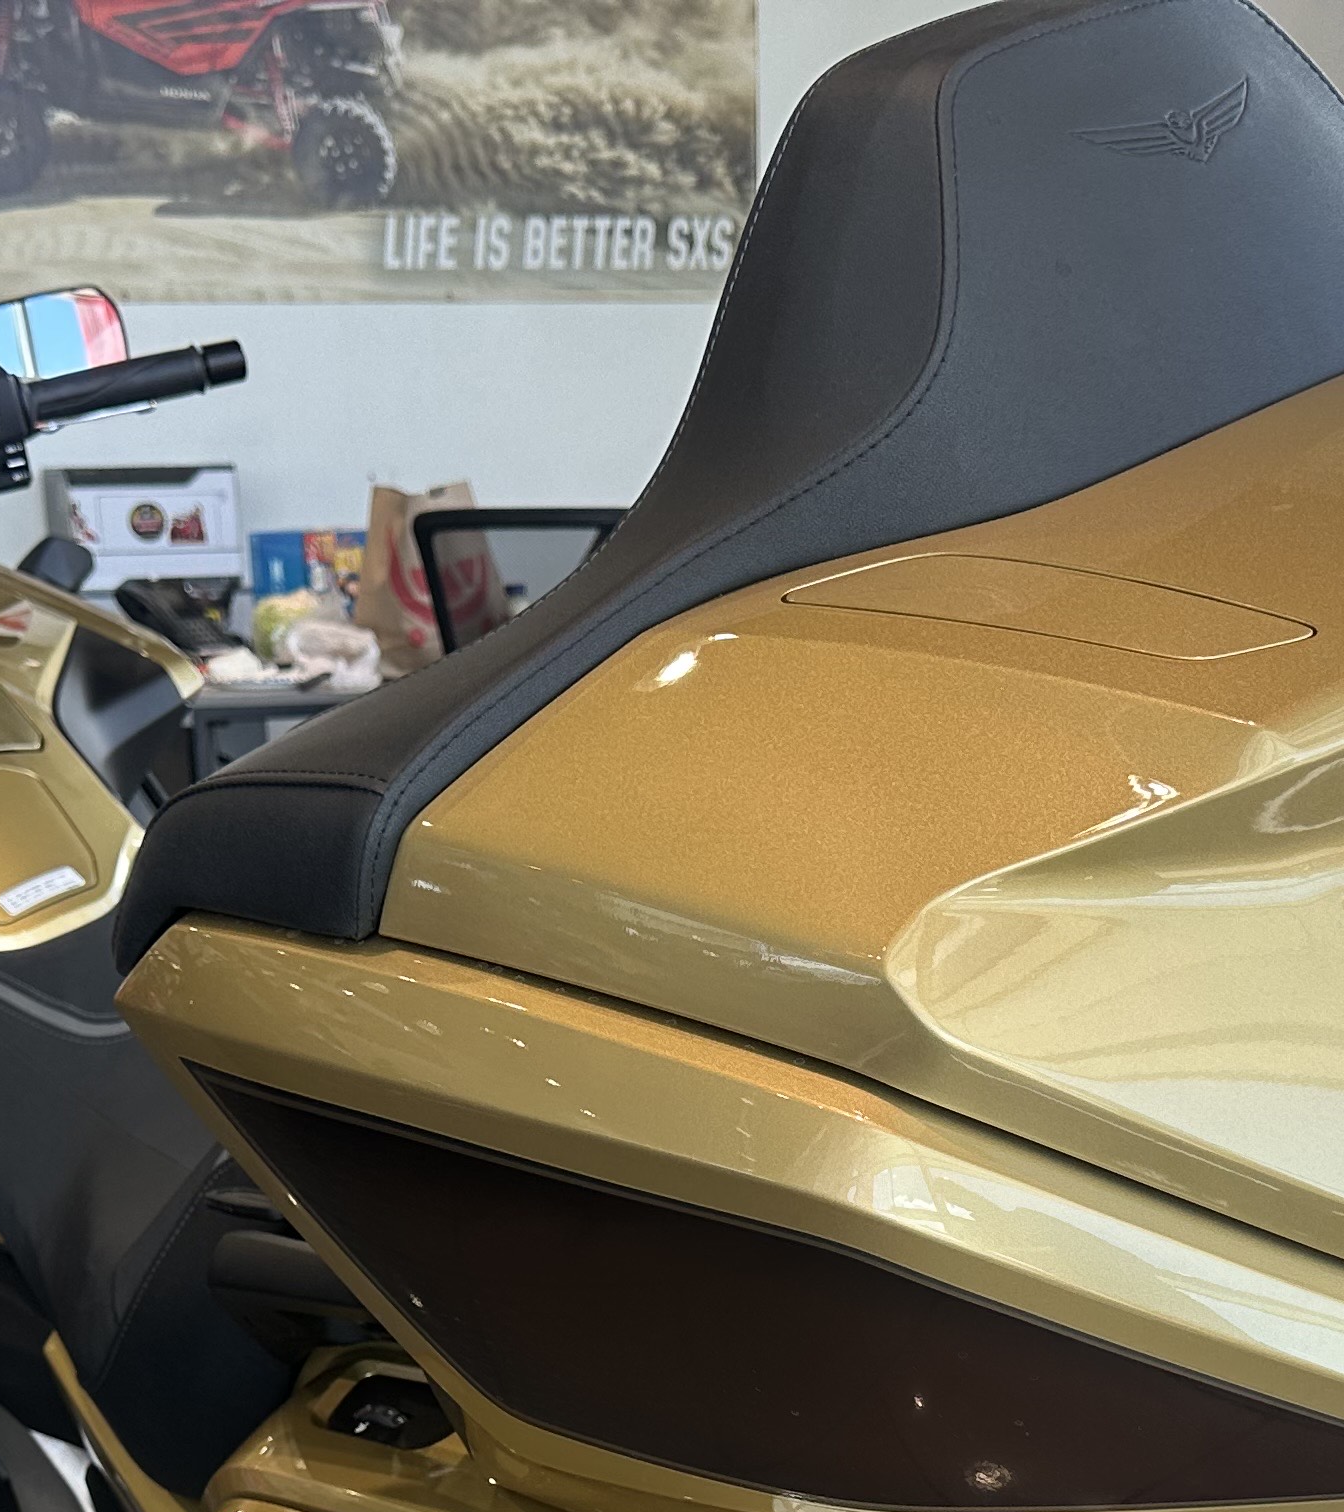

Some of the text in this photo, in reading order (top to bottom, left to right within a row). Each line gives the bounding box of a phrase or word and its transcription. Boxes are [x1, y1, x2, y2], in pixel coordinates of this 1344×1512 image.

[383, 215, 734, 271] LIFE IS BETTER SXS
